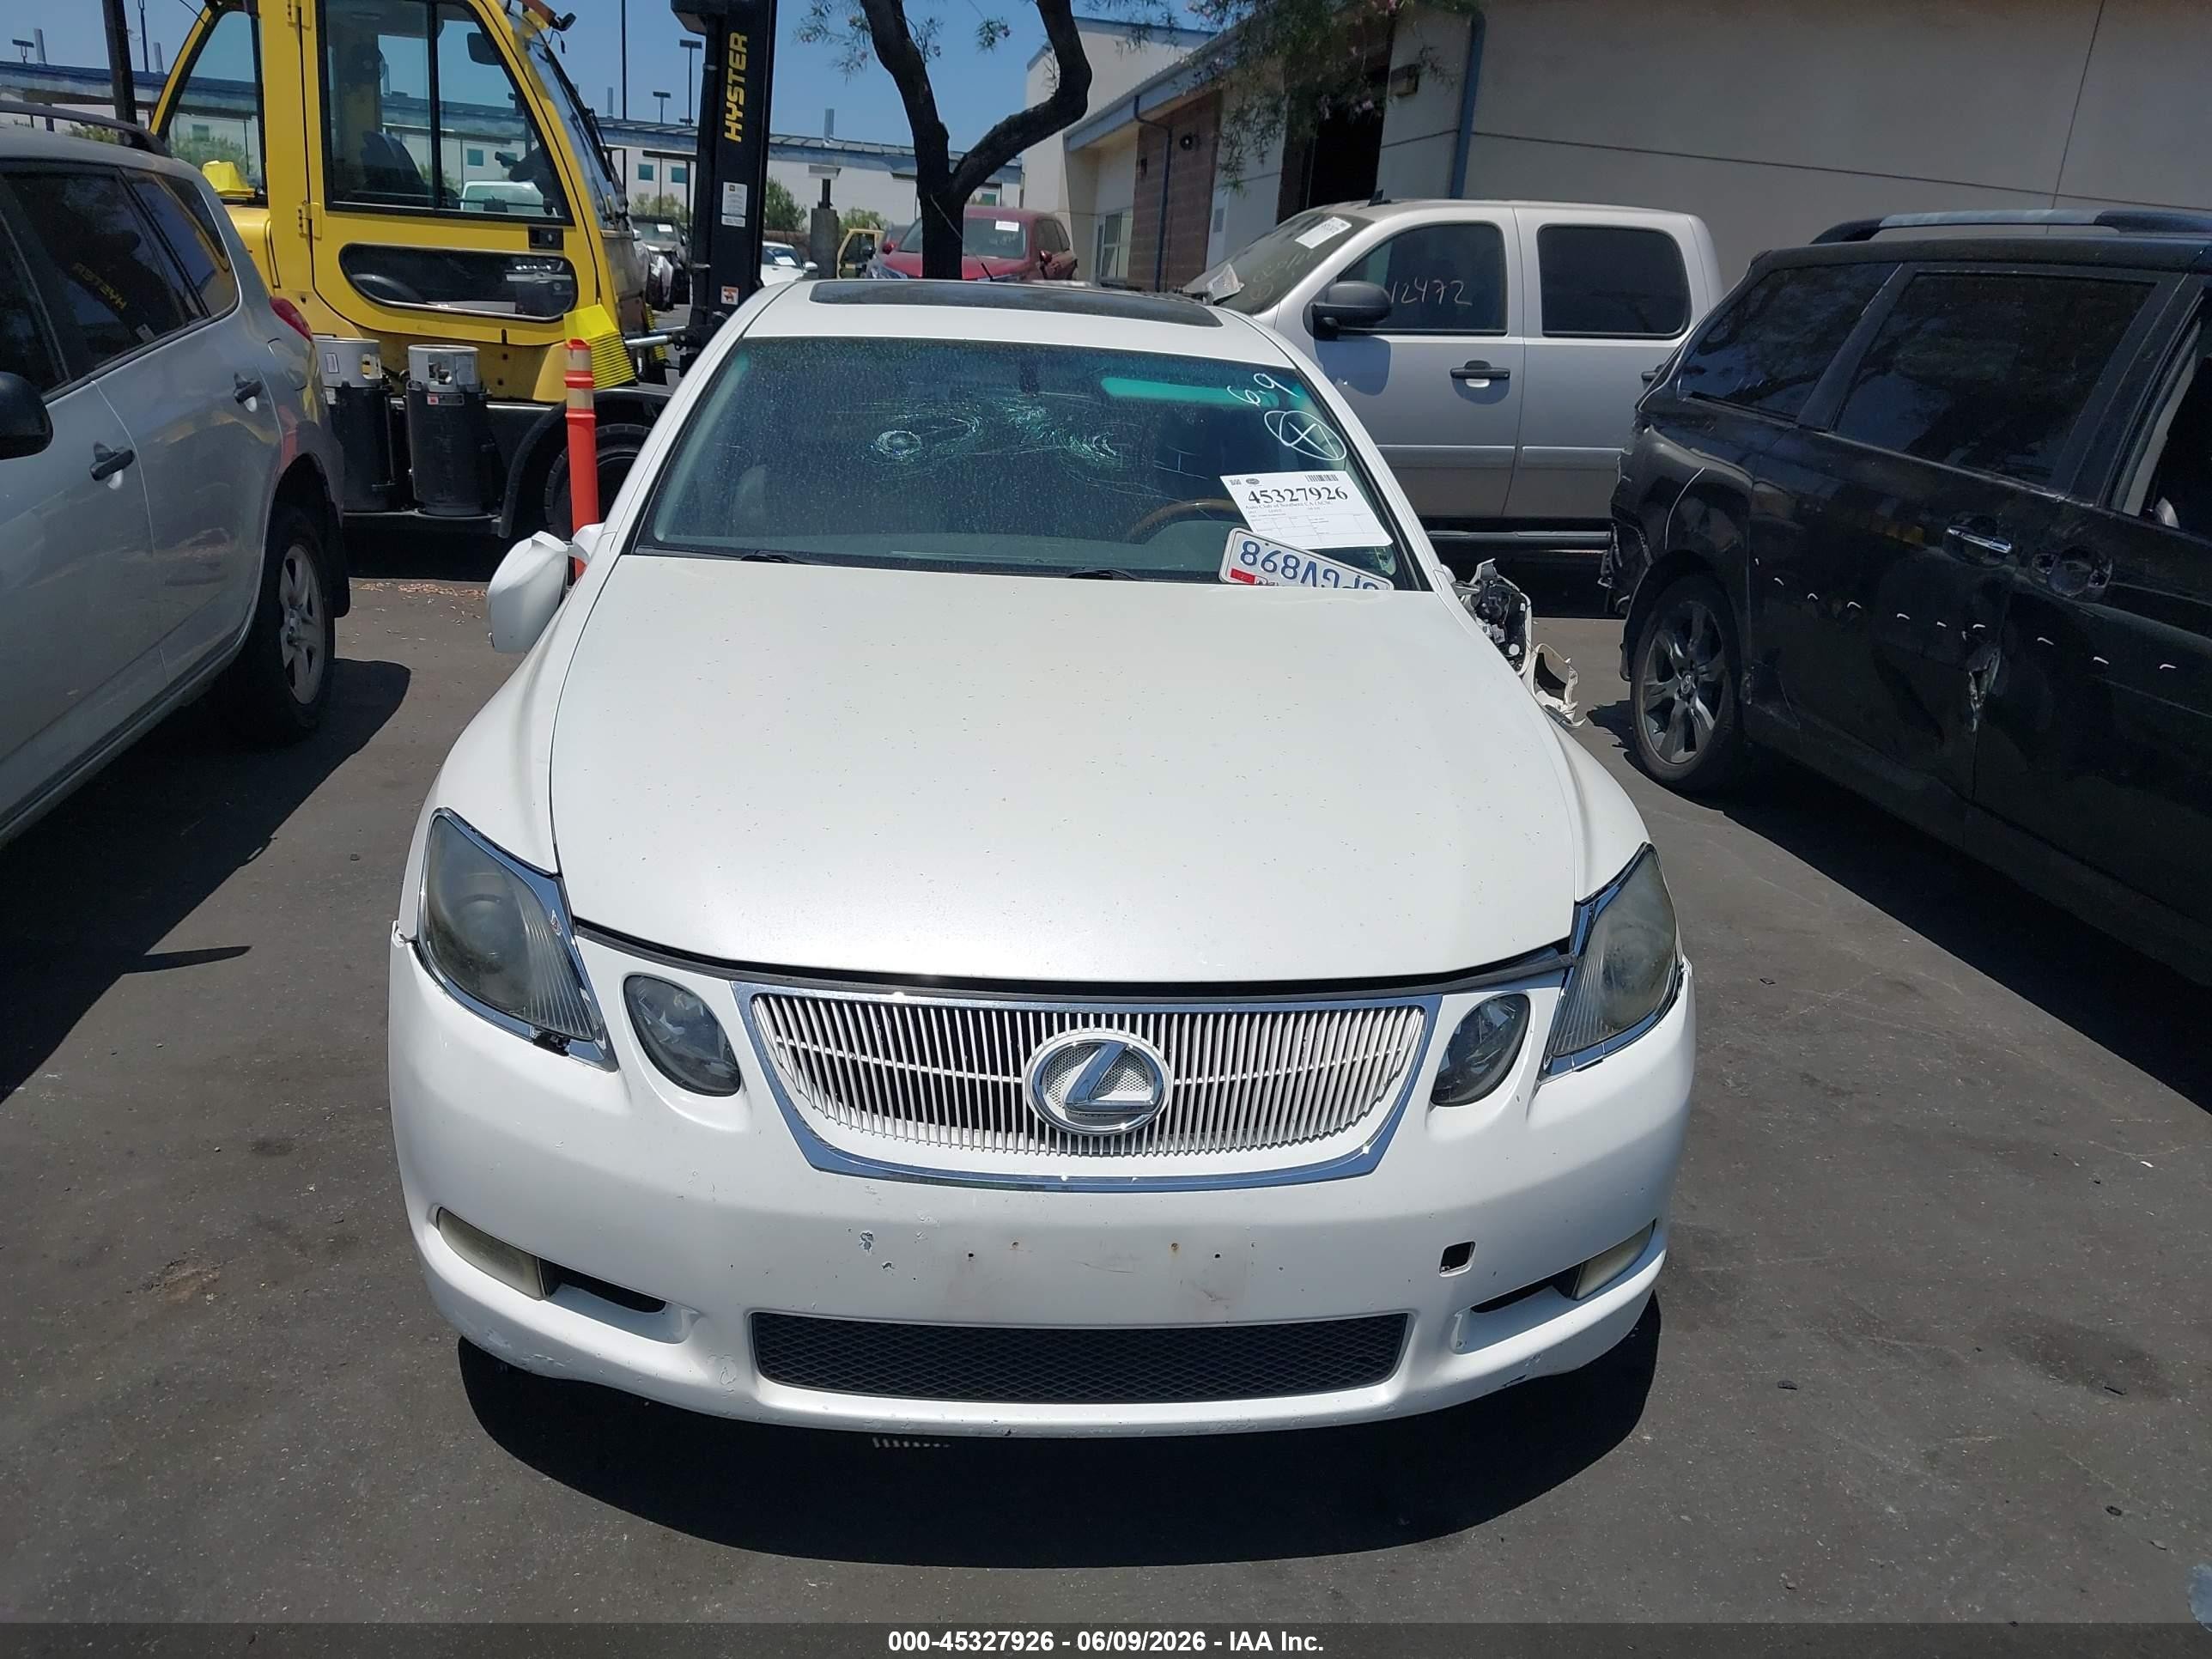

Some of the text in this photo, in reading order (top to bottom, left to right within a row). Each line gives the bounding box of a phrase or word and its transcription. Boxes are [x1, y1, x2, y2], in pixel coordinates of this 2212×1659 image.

[724, 32, 748, 143] HYSTER
[1390, 276, 1474, 307] 12472
[1248, 486, 1349, 504] 45327926
[1240, 540, 1380, 590] GV898
